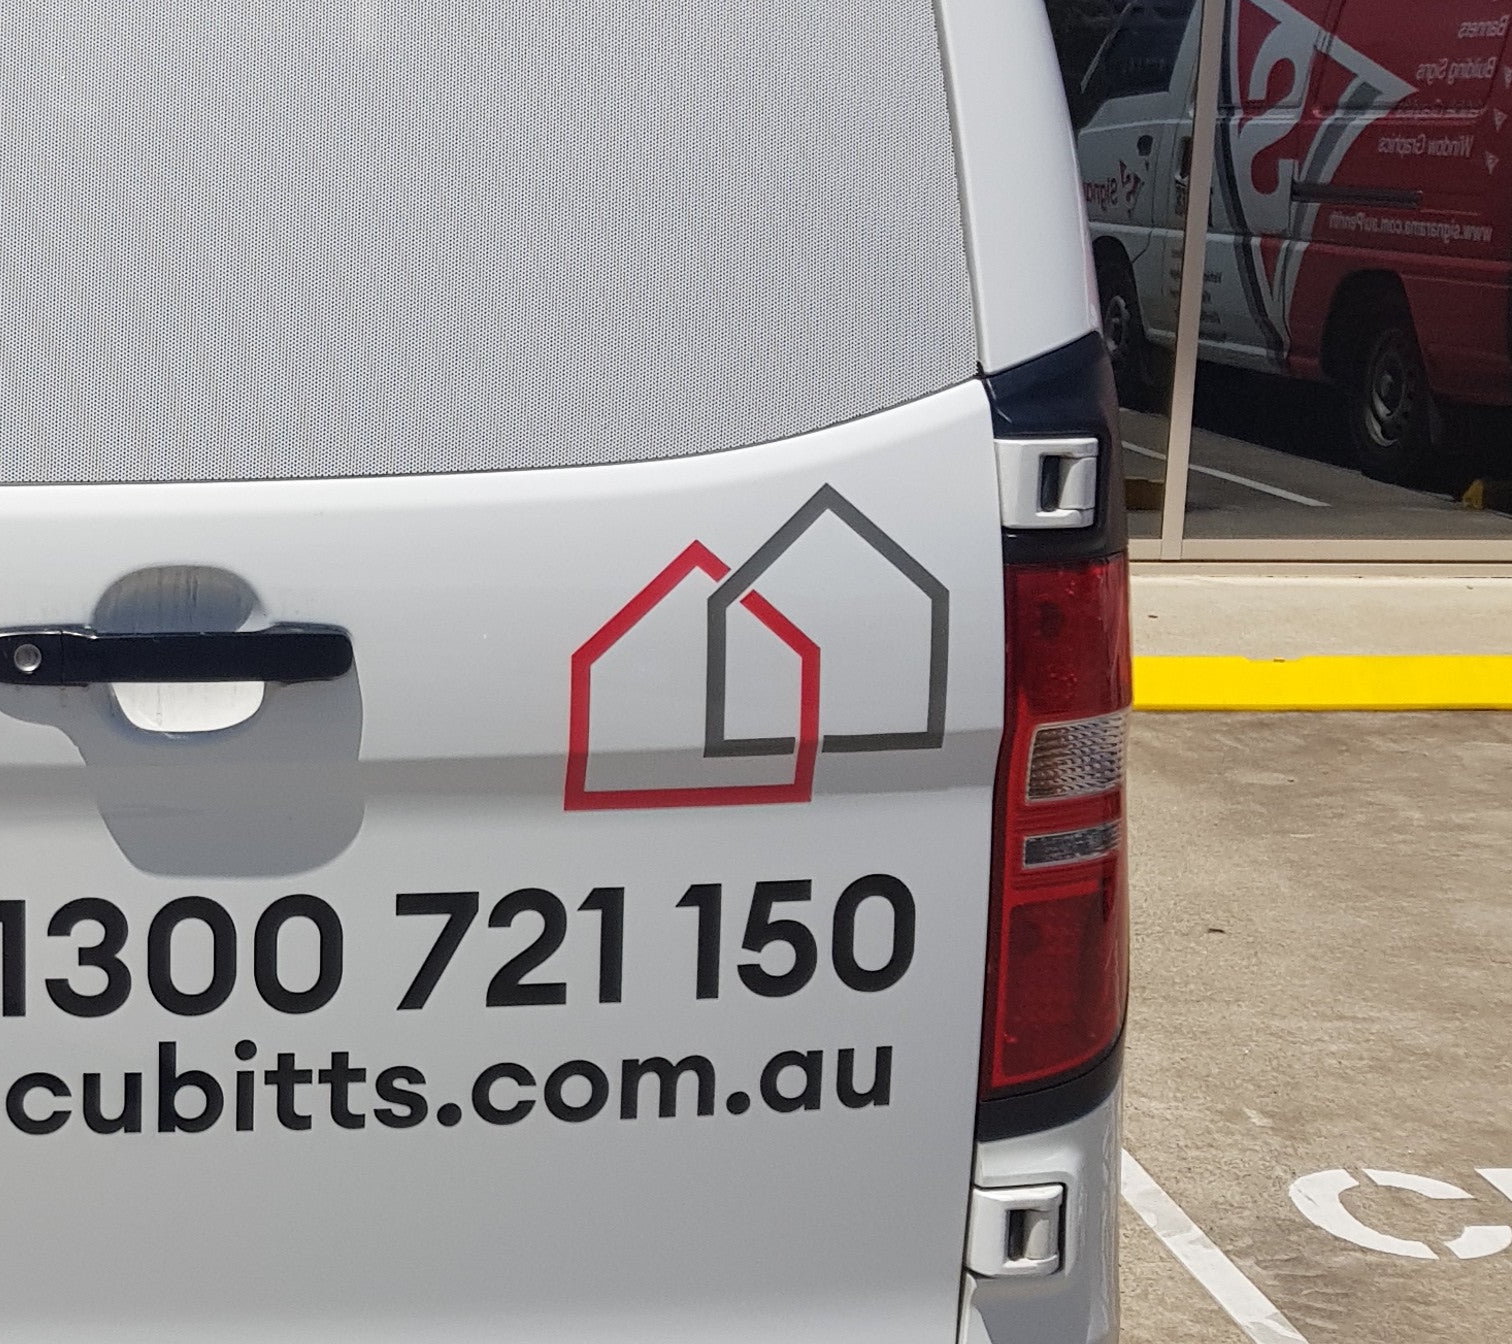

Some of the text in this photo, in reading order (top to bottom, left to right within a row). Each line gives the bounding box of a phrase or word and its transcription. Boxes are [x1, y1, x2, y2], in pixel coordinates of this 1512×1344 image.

[394, 886, 626, 1011] 721
[675, 873, 917, 1000] 150
[5, 1039, 893, 1136] cubitts.com.au
[1289, 1167, 1512, 1260] C
